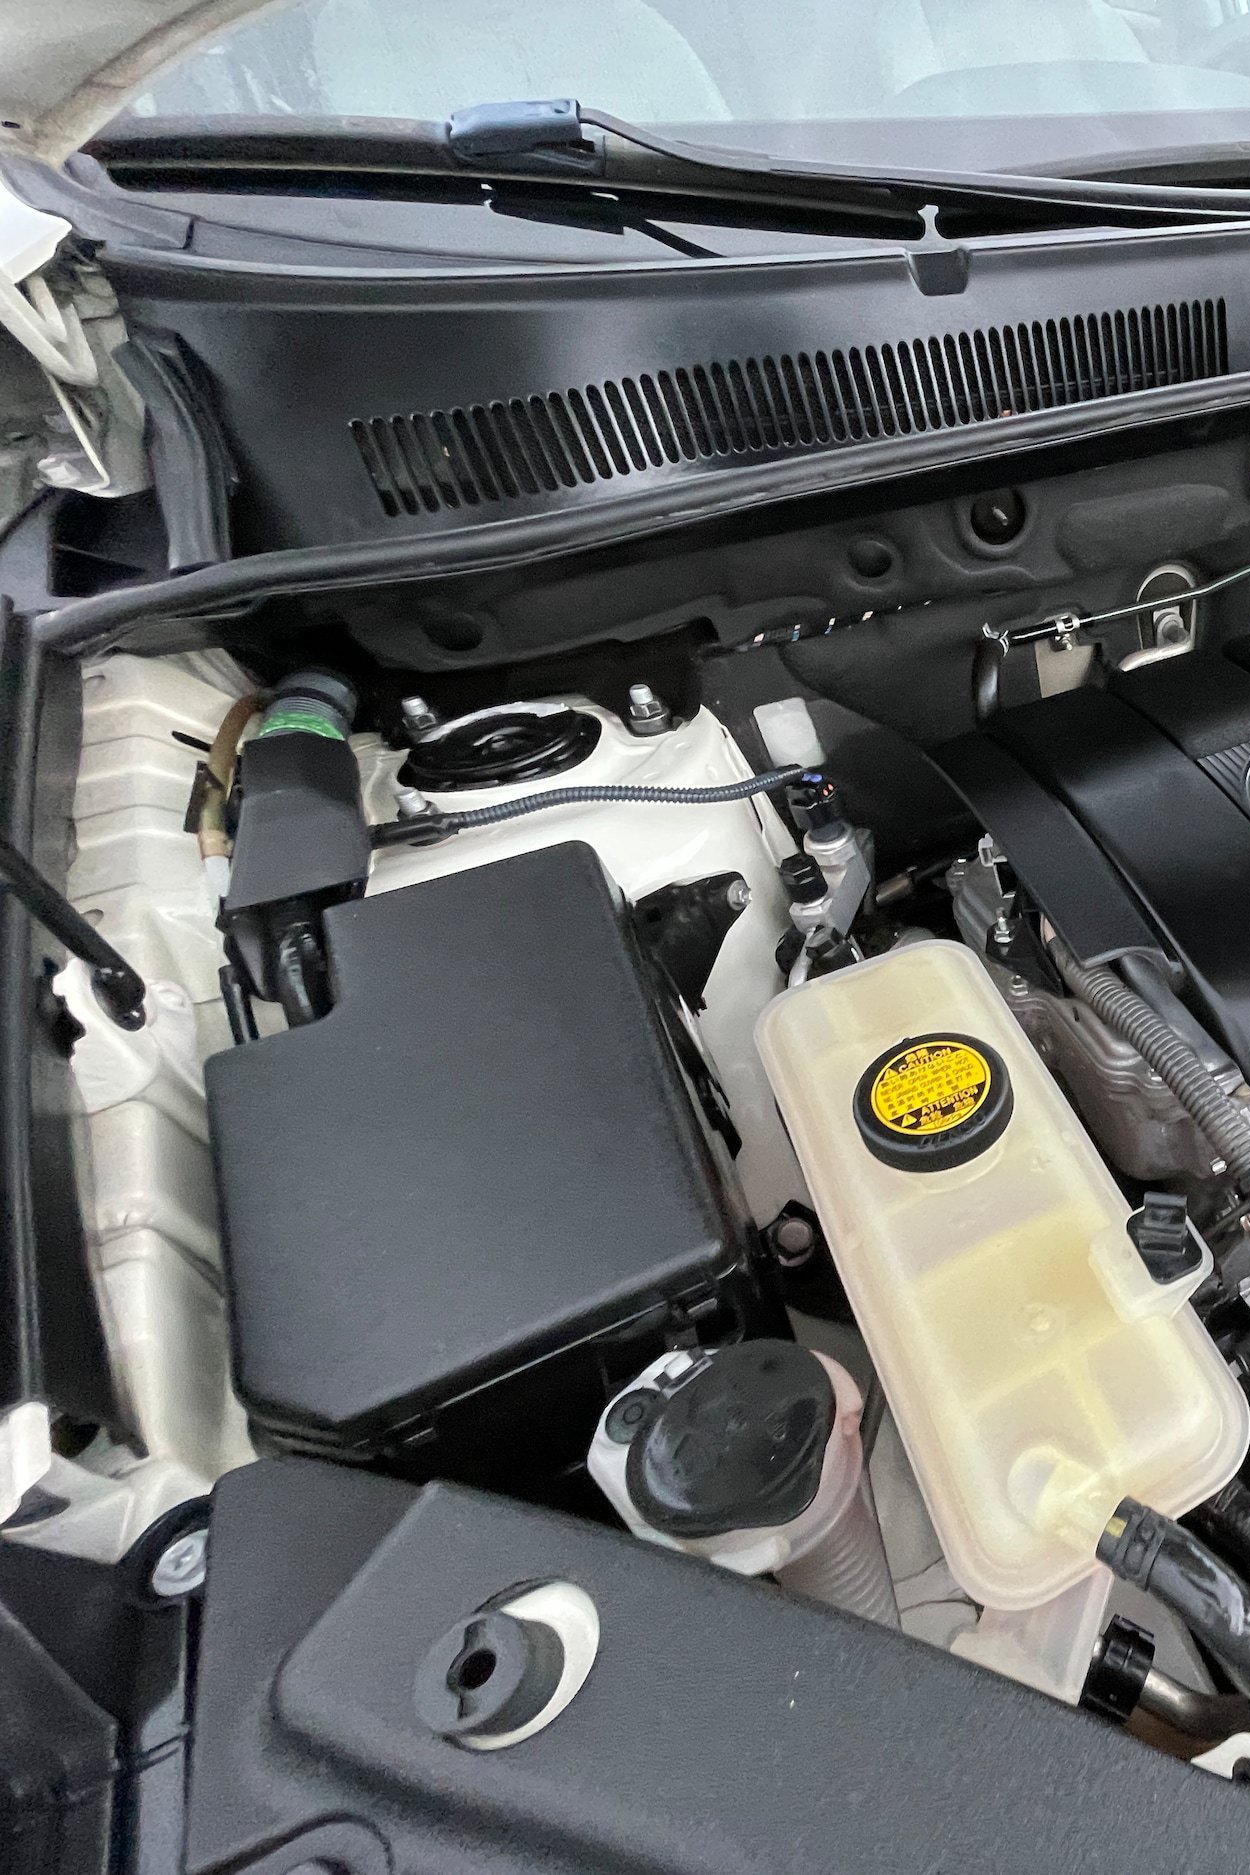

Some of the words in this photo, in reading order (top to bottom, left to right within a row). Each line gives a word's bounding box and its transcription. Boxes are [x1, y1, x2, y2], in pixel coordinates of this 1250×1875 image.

[898, 1047, 951, 1073] CAUTION
[881, 1082, 903, 1096] NEVER
[908, 1073, 928, 1085] OPEN
[930, 1063, 952, 1075] WHEN
[921, 1086, 978, 1116] ATTENTION
